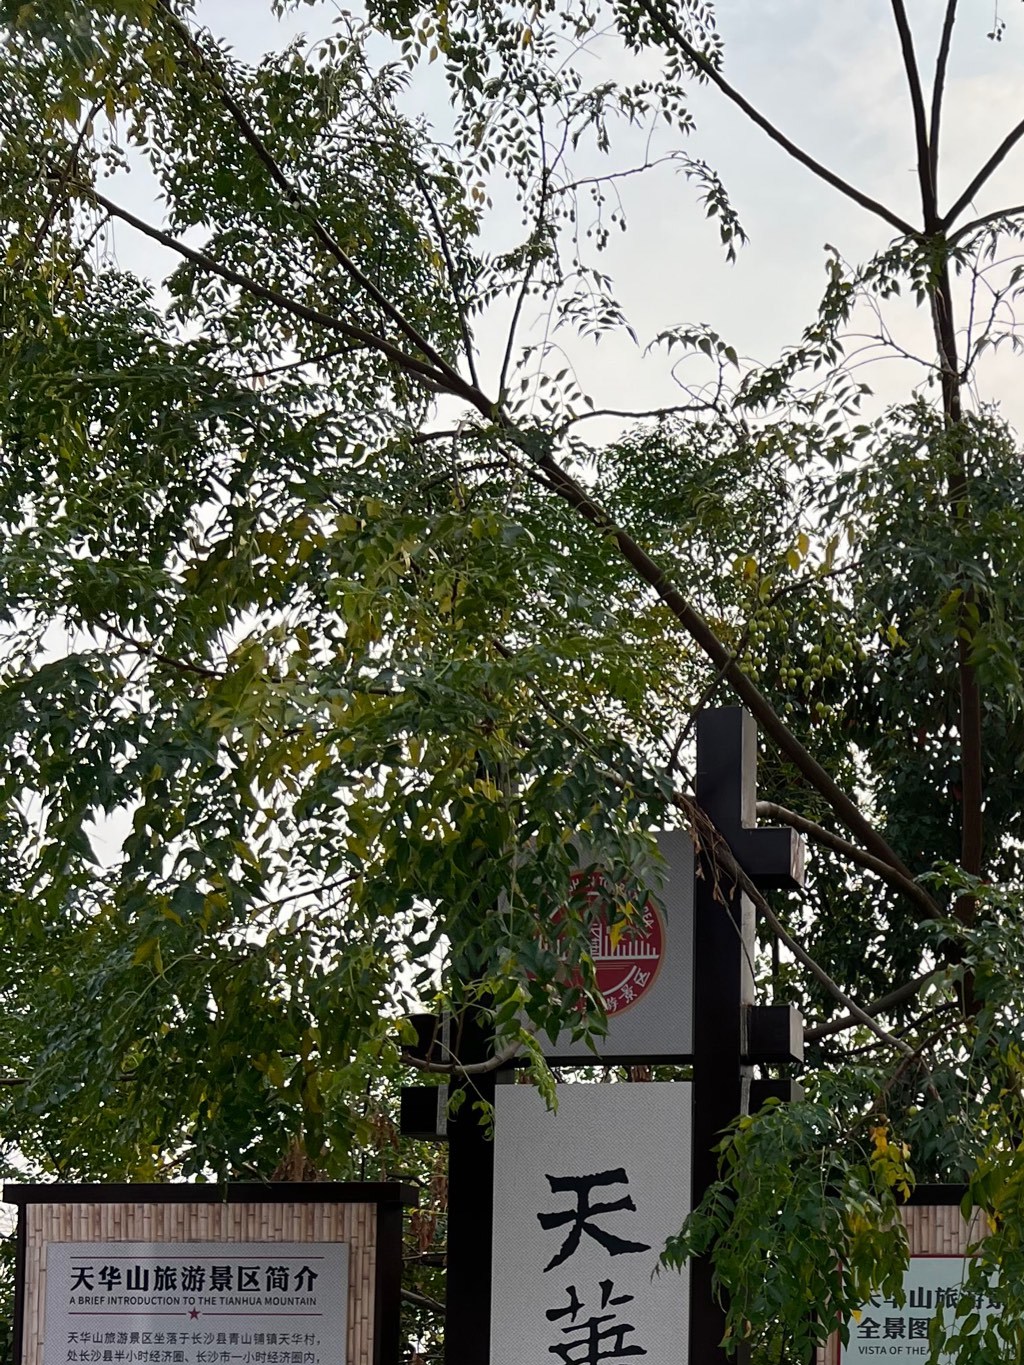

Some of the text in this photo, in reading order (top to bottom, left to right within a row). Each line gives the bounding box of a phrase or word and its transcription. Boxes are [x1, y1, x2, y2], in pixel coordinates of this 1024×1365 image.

[70, 1265, 318, 1292] 天华山旅游景区简介
[78, 1296, 104, 1304] BRIEF
[107, 1296, 179, 1305] INTRODUCTION
[182, 1296, 195, 1305] TO
[198, 1296, 216, 1305] THE
[219, 1296, 262, 1305] TIANHUA
[264, 1296, 316, 1305] MOUNTAIN
[857, 1317, 930, 1340] 全景图
[858, 1346, 925, 1355] VISTA OF THE
